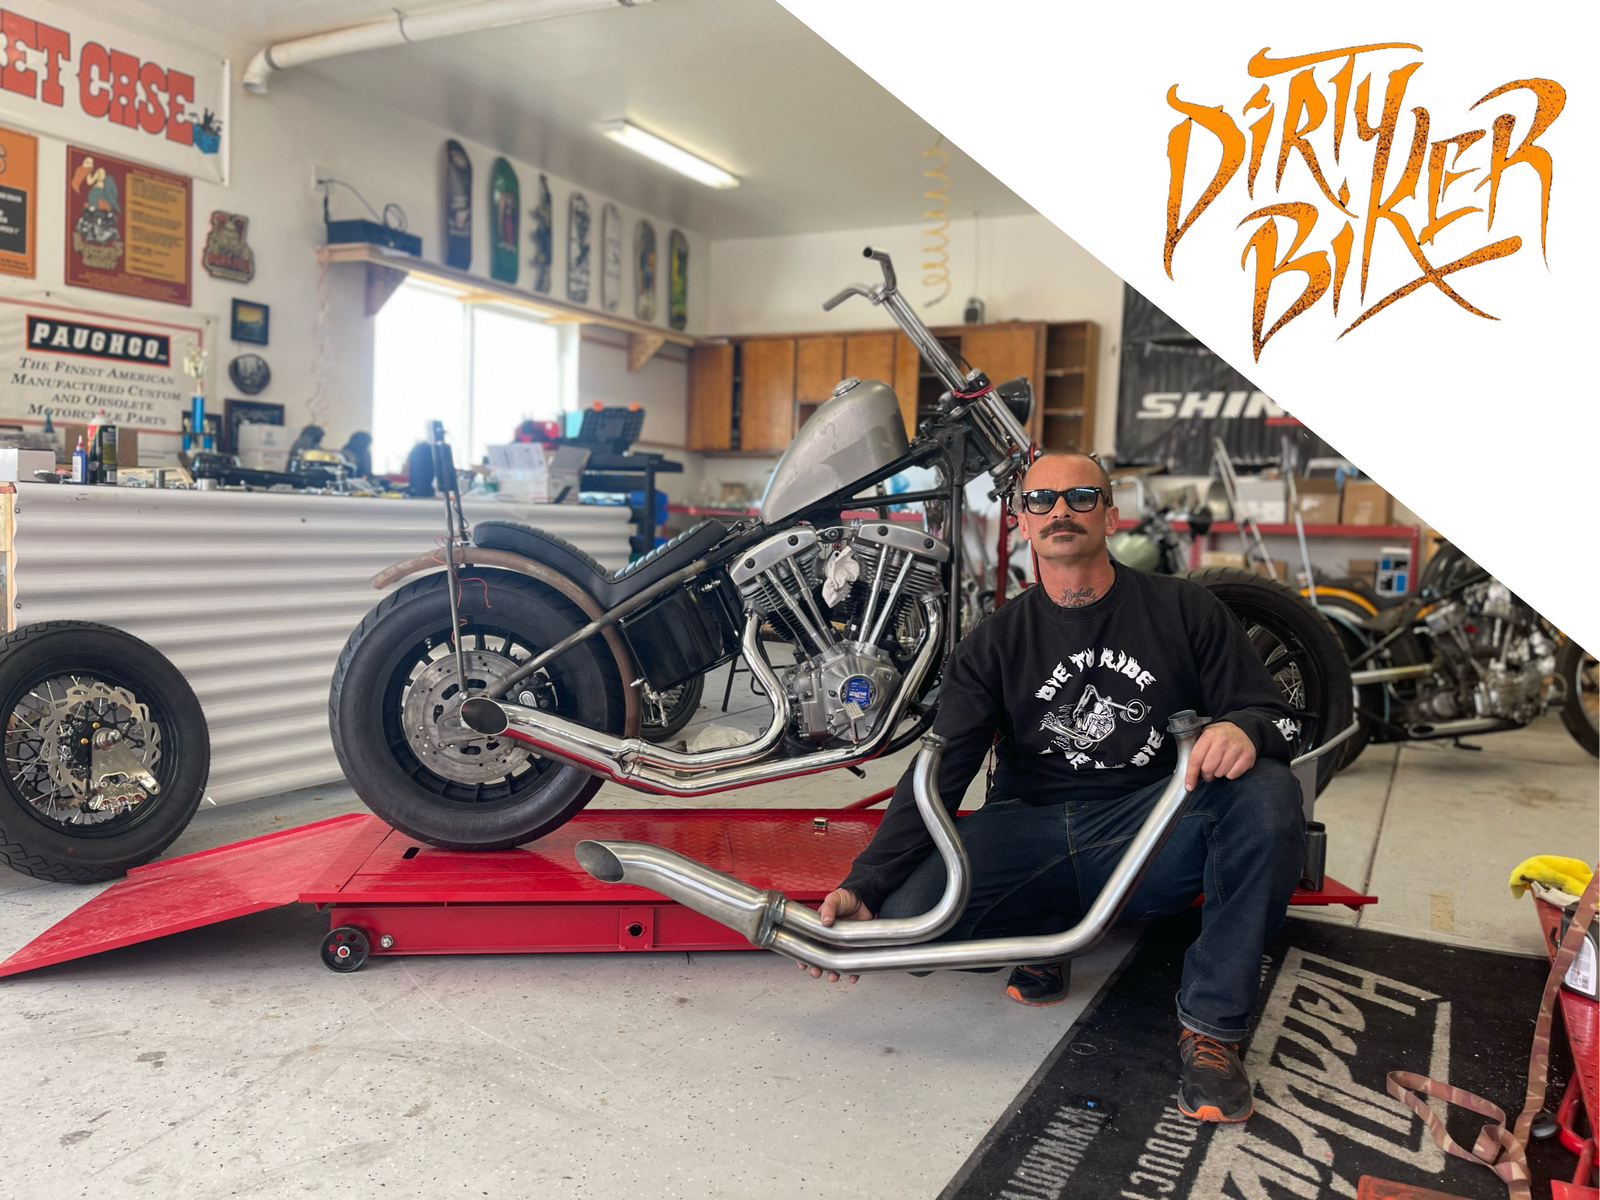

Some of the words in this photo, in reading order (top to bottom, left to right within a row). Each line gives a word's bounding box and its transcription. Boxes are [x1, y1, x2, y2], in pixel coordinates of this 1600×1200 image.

[0, 8, 70, 108] ET
[76, 41, 195, 147] CASE
[31, 322, 160, 359] PAUGHCO
[27, 403, 124, 422] MOTORCYLE
[1136, 391, 1293, 419] SHIN
[1098, 647, 1157, 692] RIDE
[1120, 1094, 1203, 1200] RODUC
